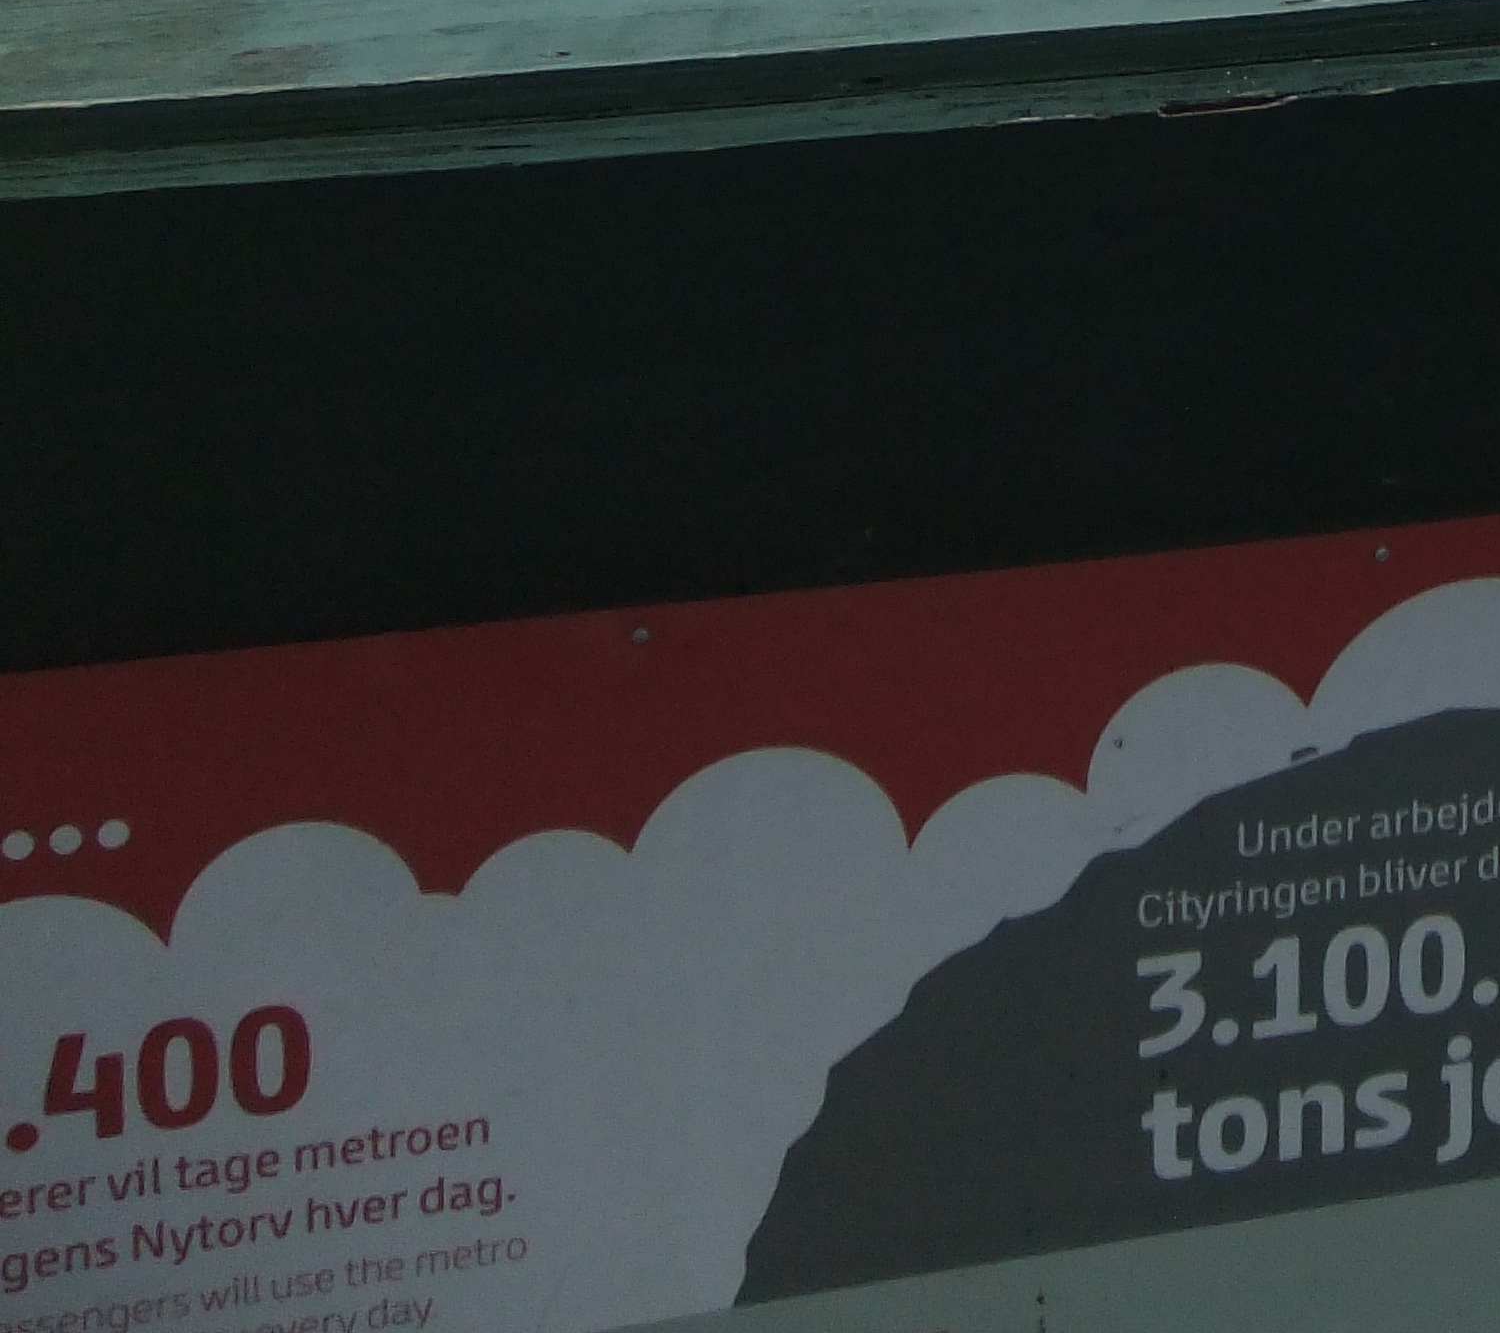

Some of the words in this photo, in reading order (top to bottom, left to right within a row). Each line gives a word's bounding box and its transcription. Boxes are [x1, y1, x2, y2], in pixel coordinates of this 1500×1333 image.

[1237, 813, 1361, 859] Under
[1137, 870, 1347, 931] Cityringen
[1358, 855, 1469, 900] bliver
[107, 1160, 162, 1202] vil
[175, 1146, 280, 1195] tage
[294, 1117, 490, 1173] metroen
[1141, 1069, 1413, 1182] tons
[2, 1238, 118, 1293] gens
[132, 1209, 293, 1265] Nytorv
[306, 1187, 409, 1233] hver
[419, 1177, 517, 1217] dag.
[201, 1275, 261, 1311] will
[271, 1268, 335, 1301] use
[345, 1257, 405, 1287] the
[416, 1237, 528, 1278] metro
